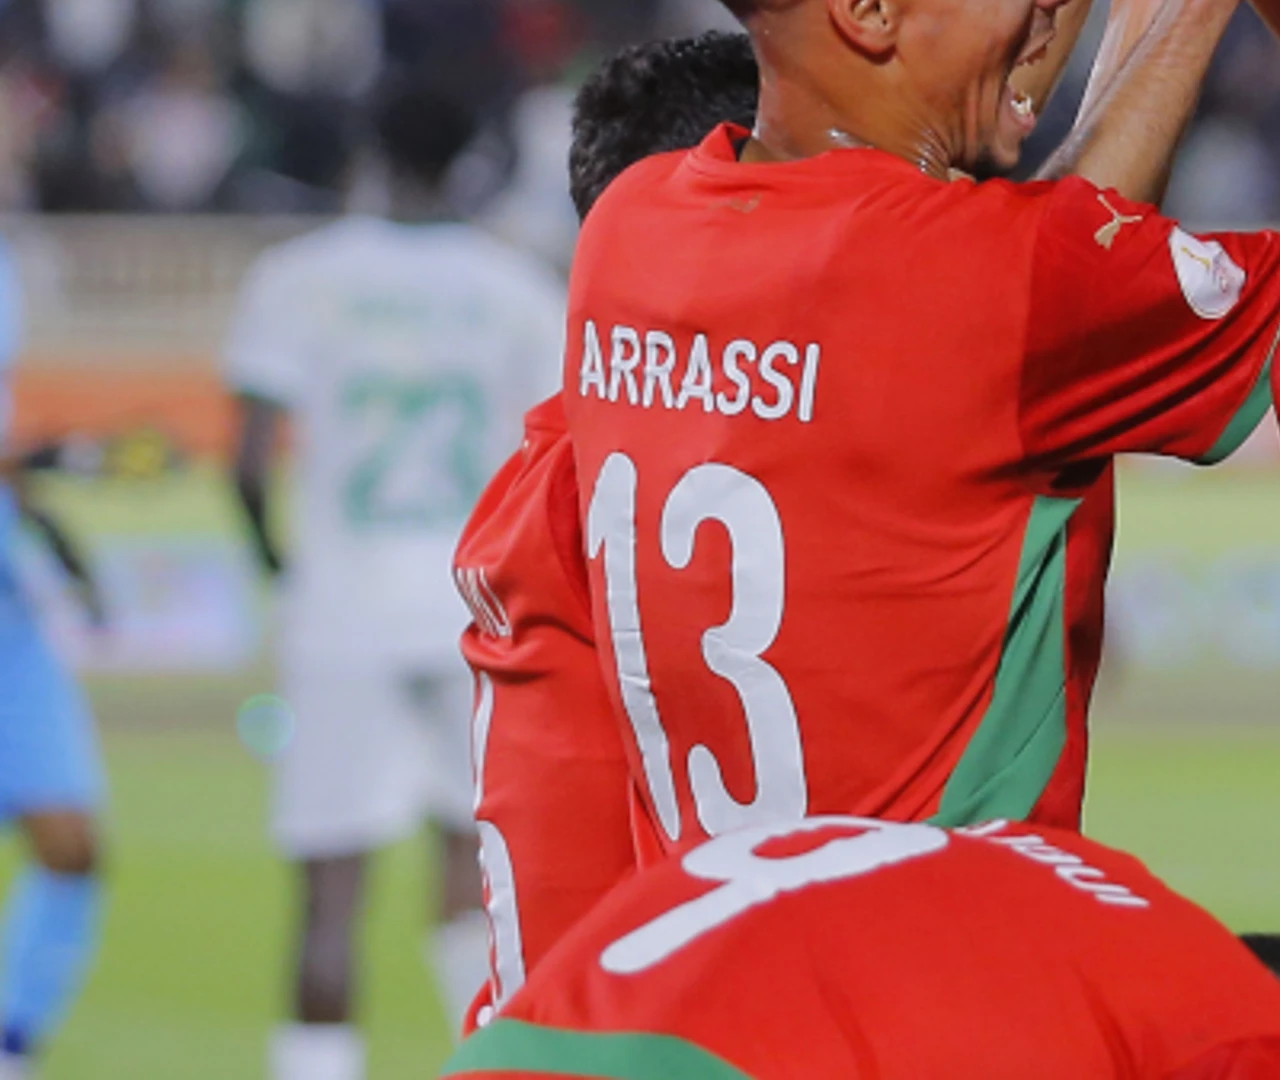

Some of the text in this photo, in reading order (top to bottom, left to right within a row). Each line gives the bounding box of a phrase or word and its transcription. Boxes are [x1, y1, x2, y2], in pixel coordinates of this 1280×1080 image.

[580, 320, 821, 422] ARRASSI
[587, 450, 808, 840] 13
[600, 816, 950, 976] 9
